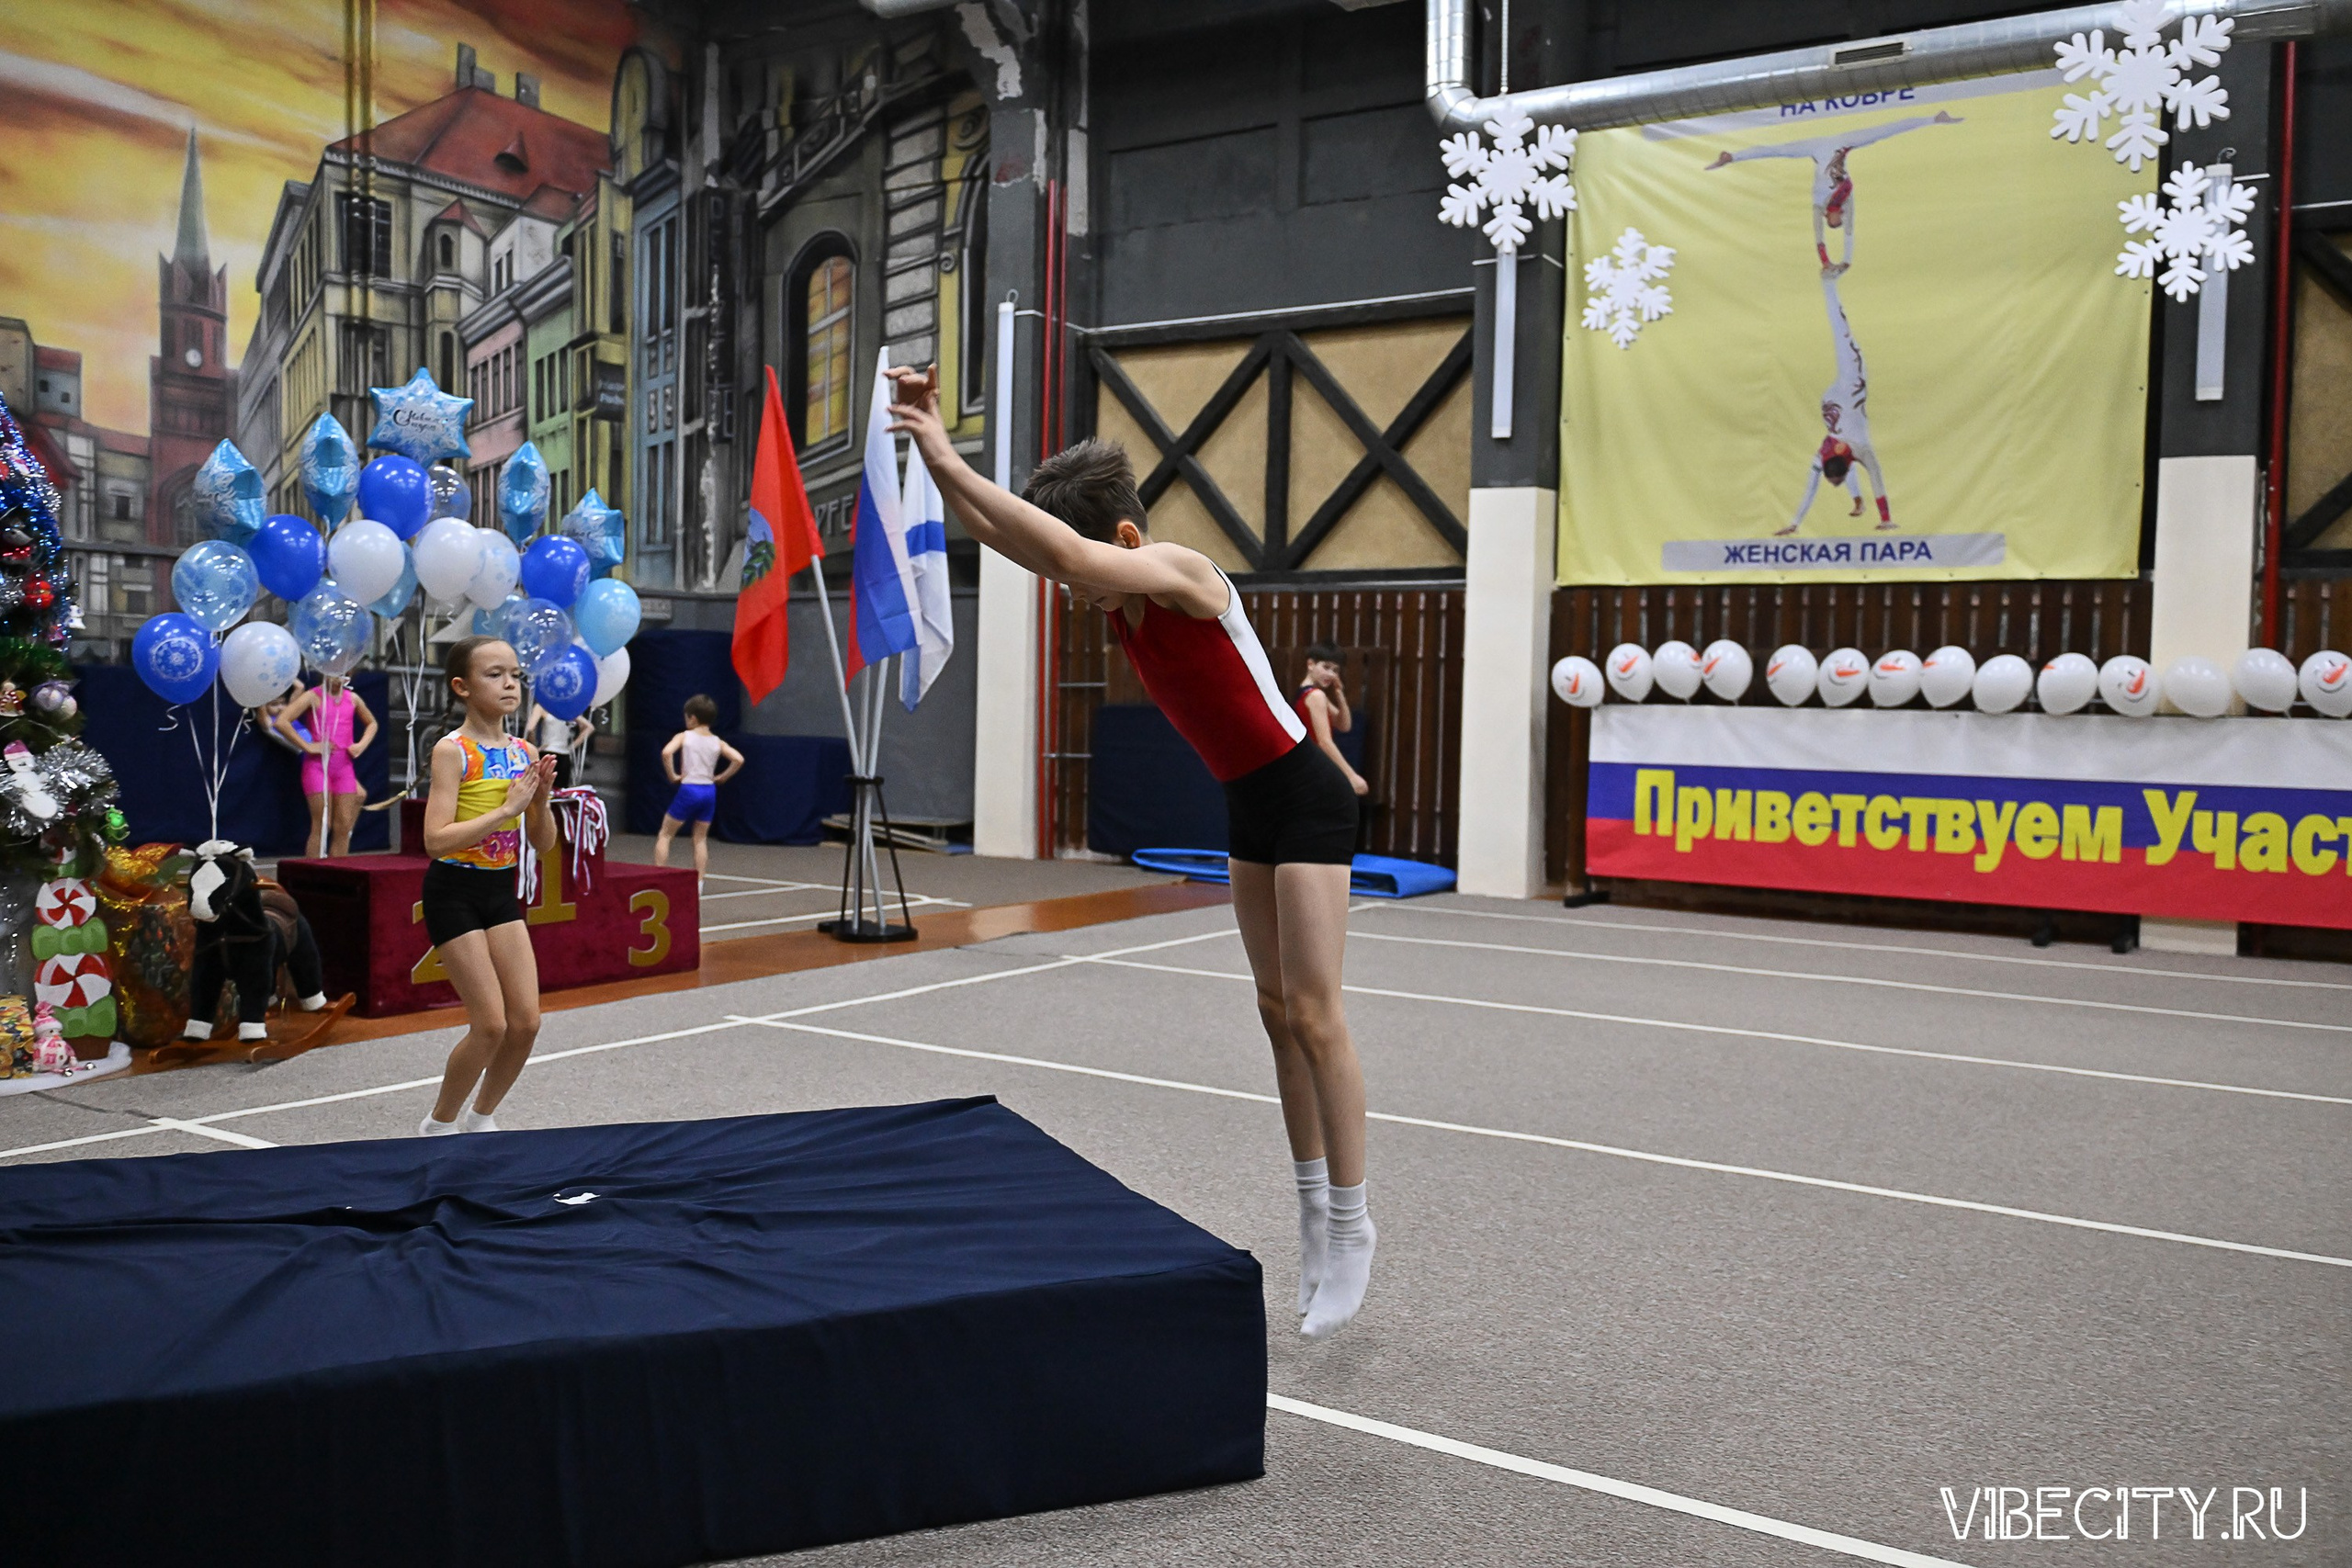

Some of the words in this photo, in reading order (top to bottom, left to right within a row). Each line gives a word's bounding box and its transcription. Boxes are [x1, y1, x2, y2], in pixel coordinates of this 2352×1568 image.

[1724, 542, 1851, 564] ЖЕНСКАЯ
[1860, 540, 1933, 562] ПАРА
[1634, 768, 2123, 874] Приветствуем
[628, 888, 672, 967] 3
